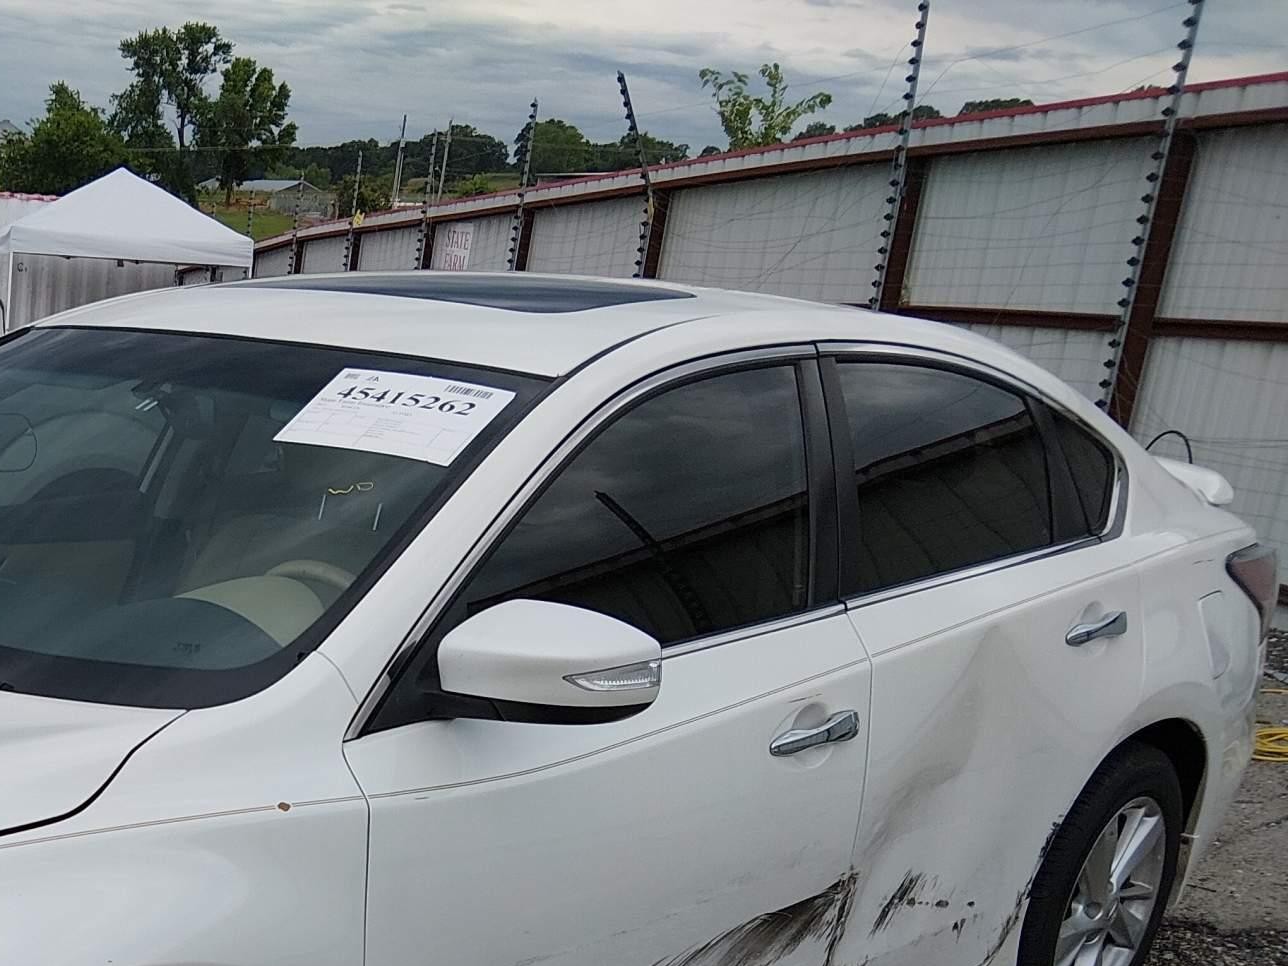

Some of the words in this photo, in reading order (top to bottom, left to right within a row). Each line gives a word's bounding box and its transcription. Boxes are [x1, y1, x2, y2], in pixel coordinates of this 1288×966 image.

[445, 230, 471, 250] STATE
[443, 252, 466, 271] FARM
[337, 385, 476, 416] 45415262
